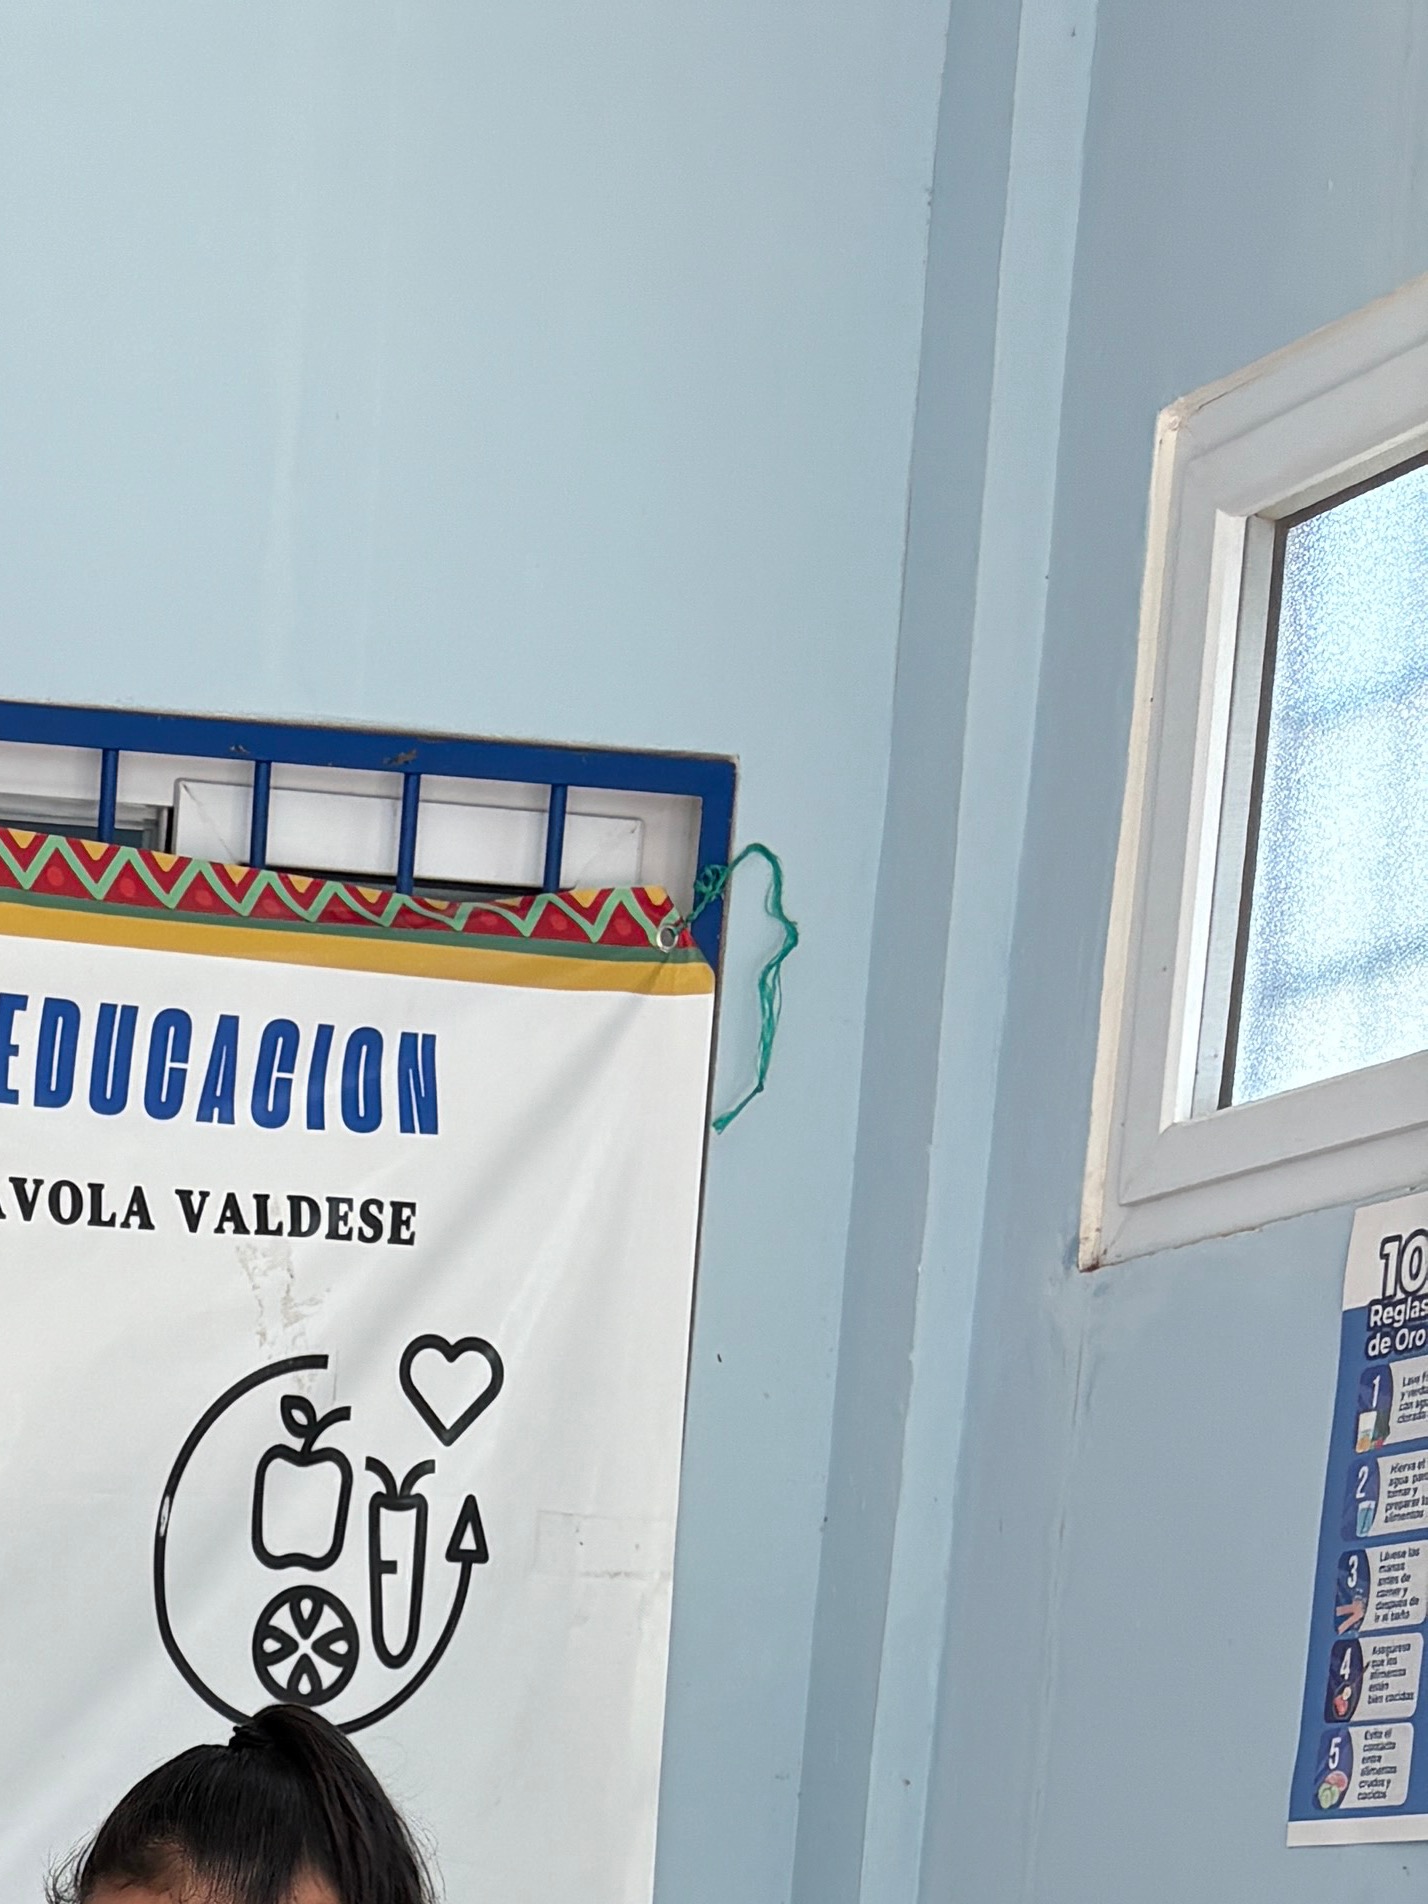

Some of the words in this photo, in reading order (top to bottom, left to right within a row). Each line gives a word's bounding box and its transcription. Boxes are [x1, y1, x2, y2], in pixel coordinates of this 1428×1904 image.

[174, 1188, 418, 1246] VALDESE
[1380, 1229, 1428, 1298] 10
[1368, 1332, 1392, 1357] de
[1395, 1327, 1426, 1352] Oro
[1372, 1374, 1382, 1408] 1
[1356, 1465, 1369, 1499] 2
[1347, 1554, 1359, 1588] 3
[1339, 1647, 1352, 1680] 4
[1328, 1736, 1342, 1770] 5
